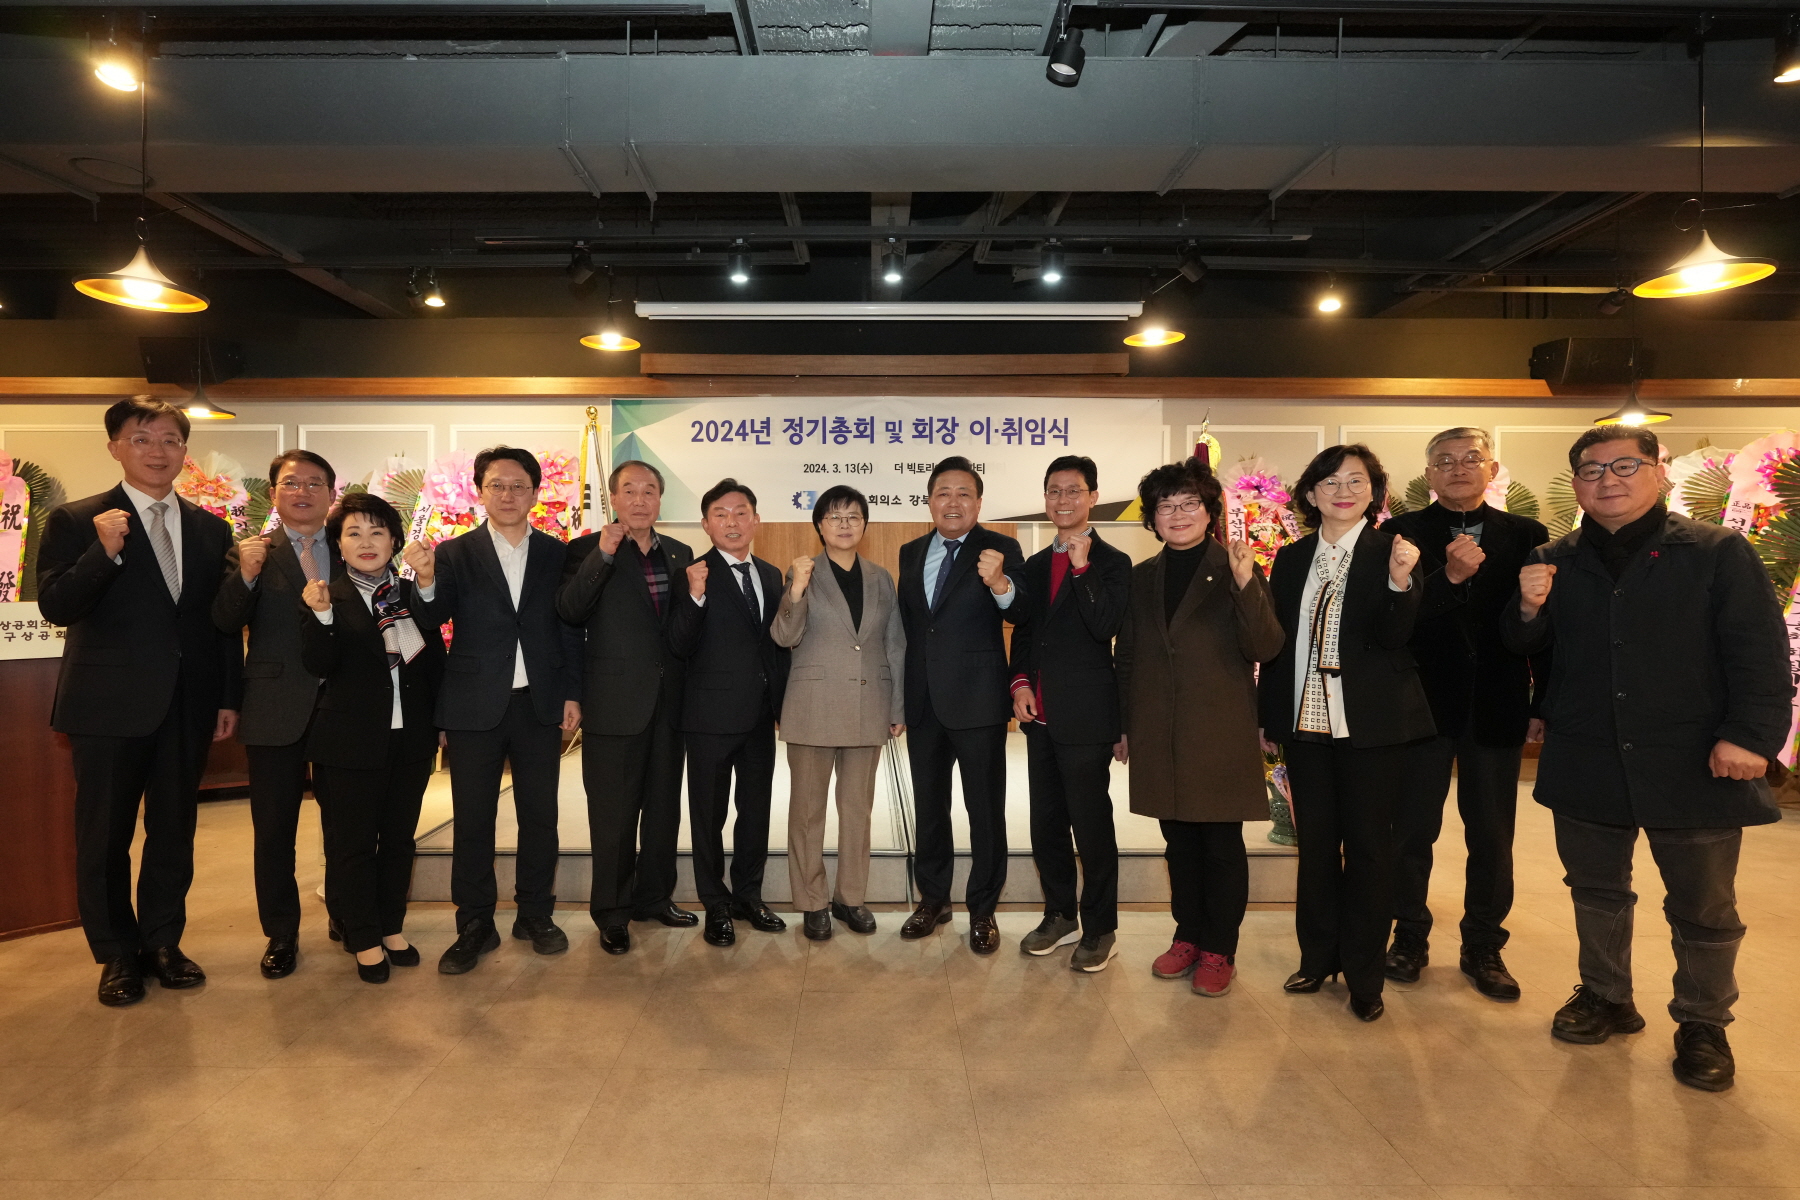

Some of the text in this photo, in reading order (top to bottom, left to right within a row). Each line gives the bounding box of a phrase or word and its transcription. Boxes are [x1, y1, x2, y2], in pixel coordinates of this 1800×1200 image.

[690, 416, 771, 445] 2024년
[782, 415, 875, 445] 정기총회
[885, 419, 904, 444] 및
[911, 416, 959, 445] 회장
[803, 463, 829, 474] 2024.
[832, 463, 841, 474] 3.
[844, 462, 873, 475] 13(수)
[894, 462, 904, 474] 더
[906, 462, 937, 475] 빅토리
[2, 503, 23, 530] 祝
